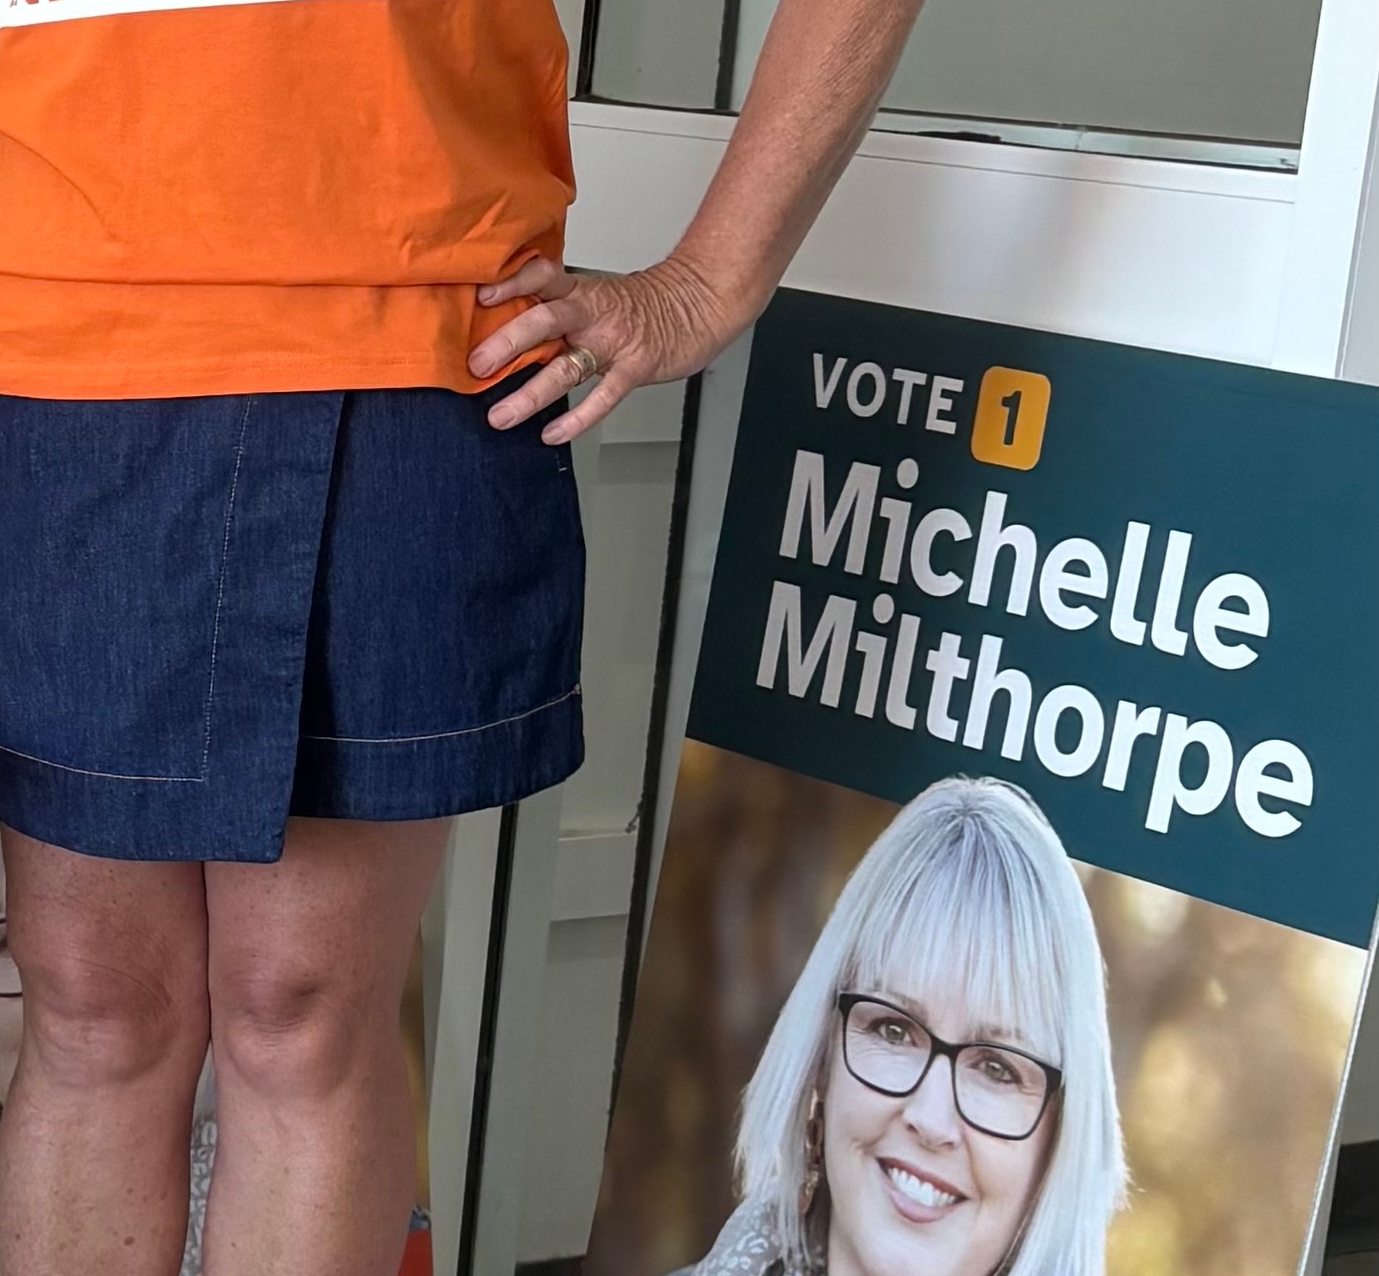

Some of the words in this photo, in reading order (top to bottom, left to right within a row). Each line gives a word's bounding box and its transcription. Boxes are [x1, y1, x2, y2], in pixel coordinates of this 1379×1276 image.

[812, 353, 964, 435] VOTE
[1000, 389, 1023, 446] 1
[779, 449, 1270, 670] Michelle
[755, 580, 1314, 839] Milthorpe
